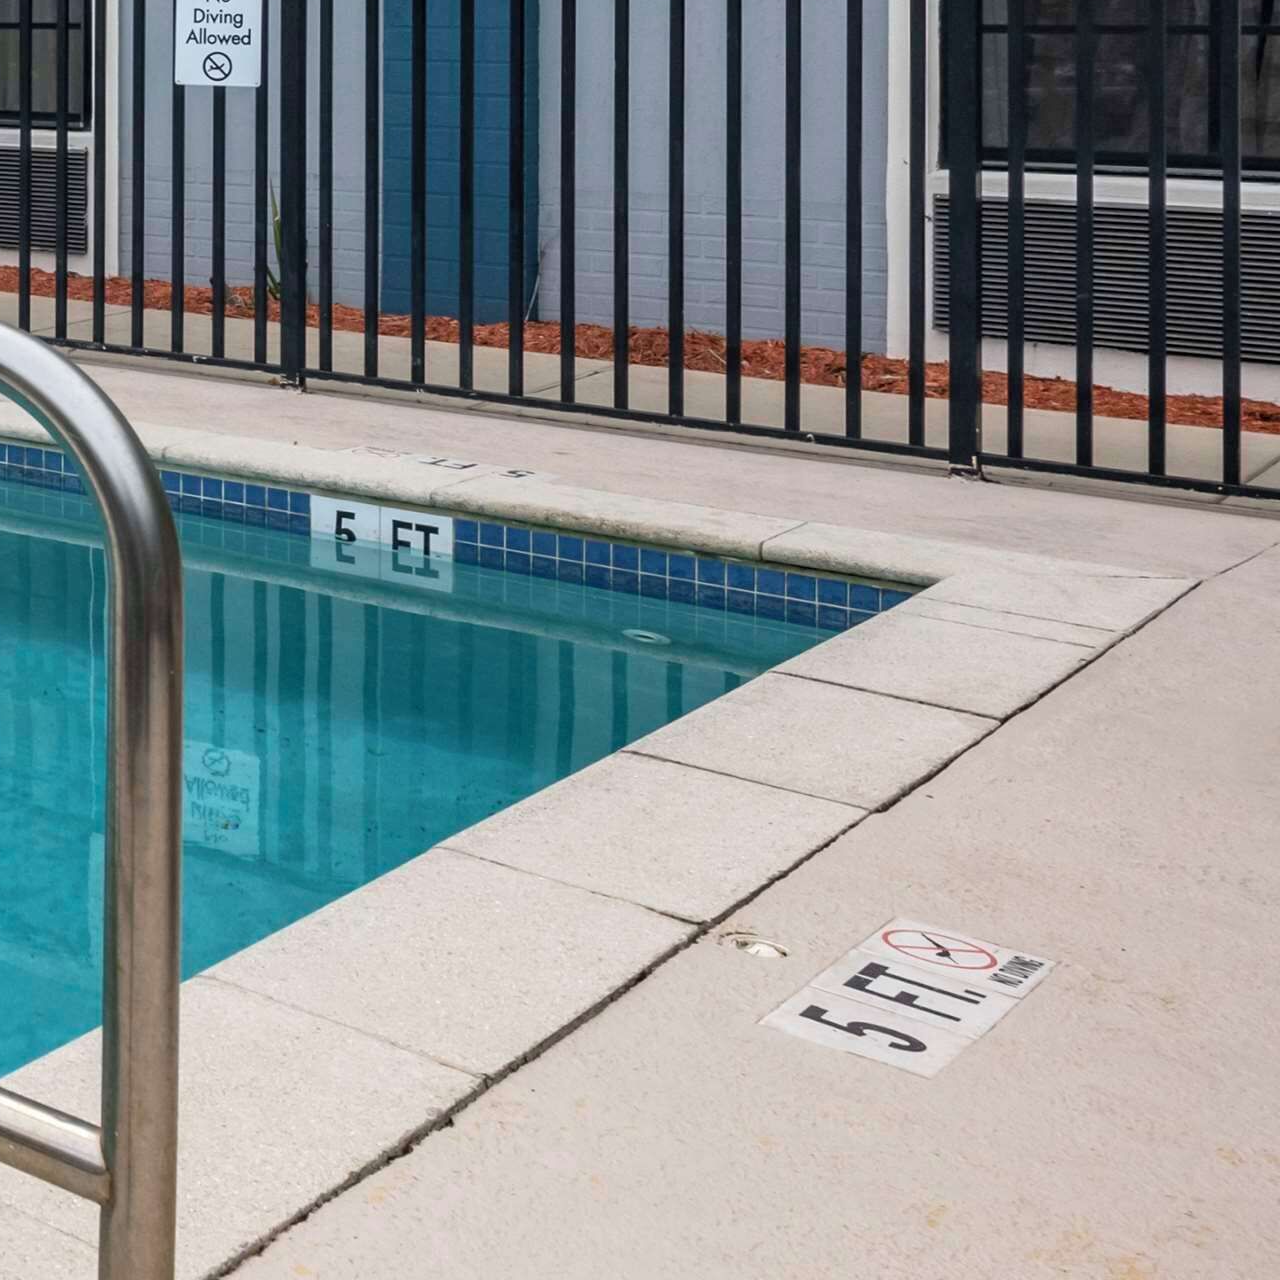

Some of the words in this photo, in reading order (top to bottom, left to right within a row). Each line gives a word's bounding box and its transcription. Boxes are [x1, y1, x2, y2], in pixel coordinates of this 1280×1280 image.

[193, 8, 244, 29] Diving
[185, 27, 252, 46] Allowed
[335, 509, 357, 543] 5
[392, 519, 439, 556] FT
[798, 1004, 928, 1053] 5
